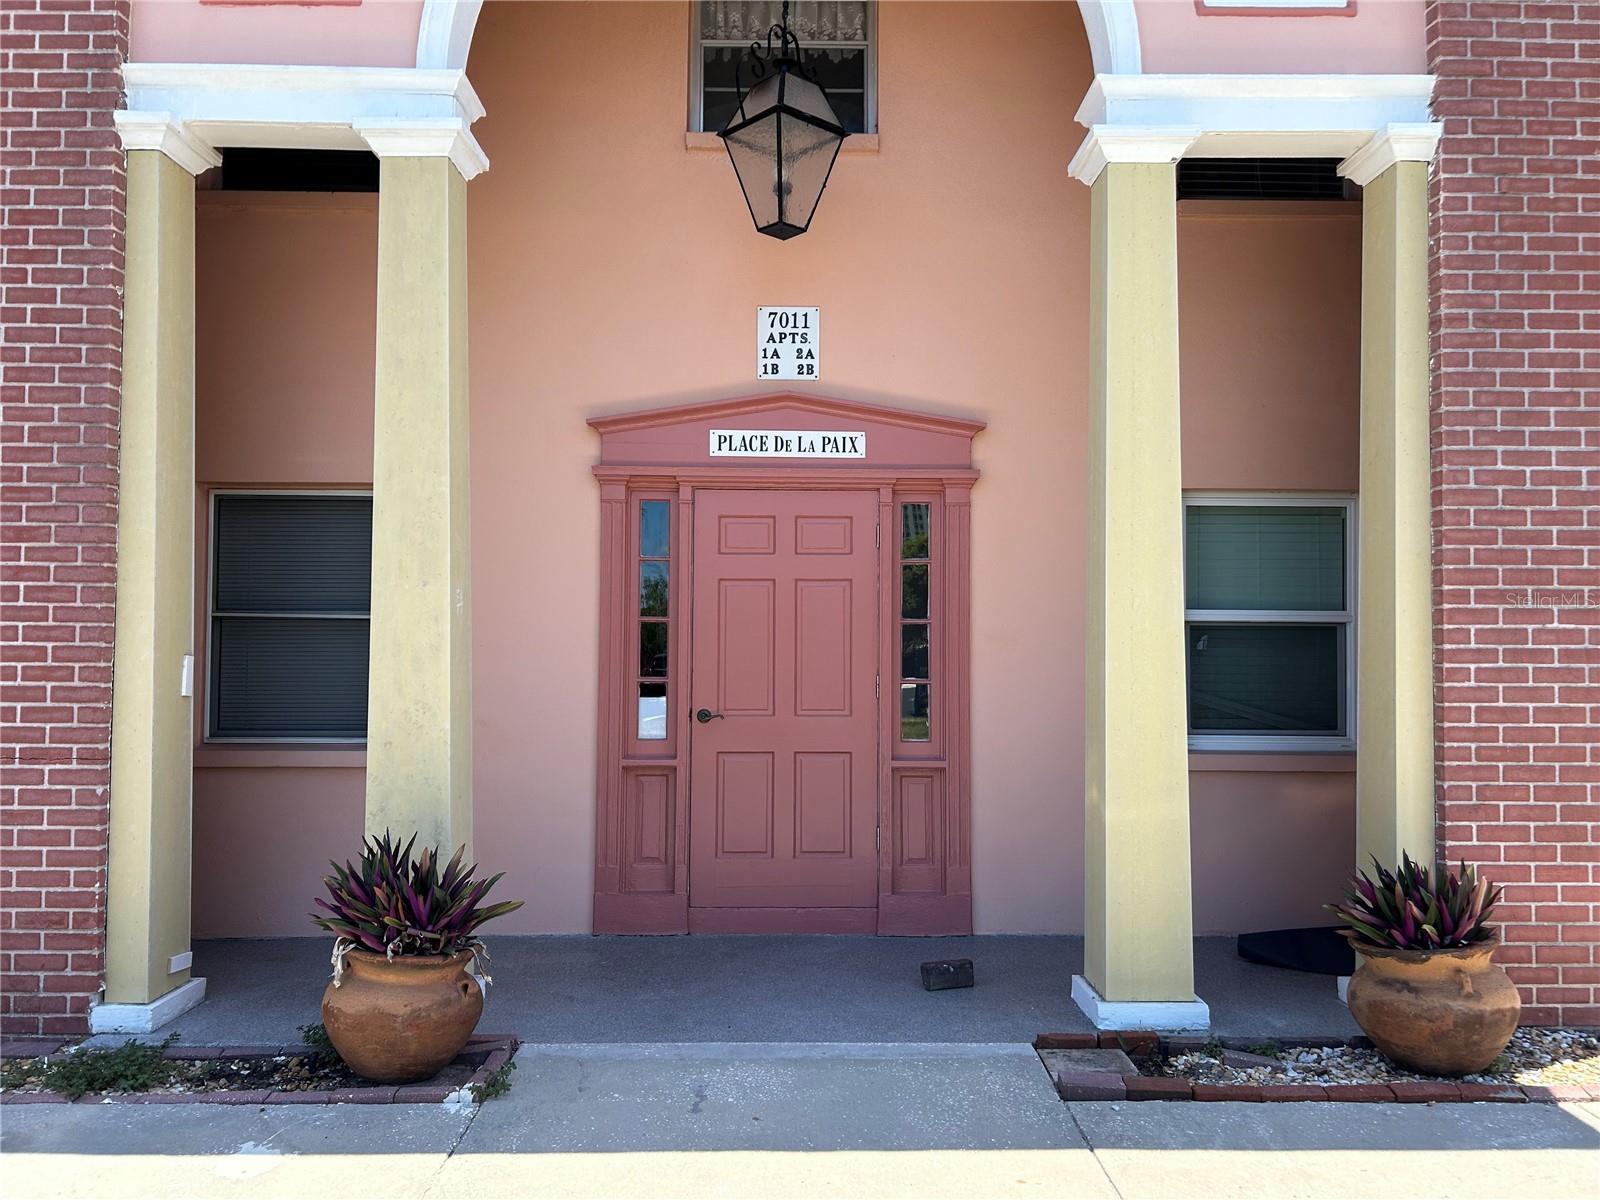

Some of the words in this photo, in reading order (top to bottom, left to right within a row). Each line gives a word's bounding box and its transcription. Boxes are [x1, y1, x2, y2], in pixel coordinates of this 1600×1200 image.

[768, 311, 810, 329] 7011
[766, 332, 811, 344] APTS.
[761, 347, 781, 360] 1A
[795, 348, 816, 360] 2A
[762, 363, 780, 375] 1B
[796, 363, 815, 376] 2B
[717, 434, 769, 452] PLACE
[821, 436, 859, 453] PAIX
